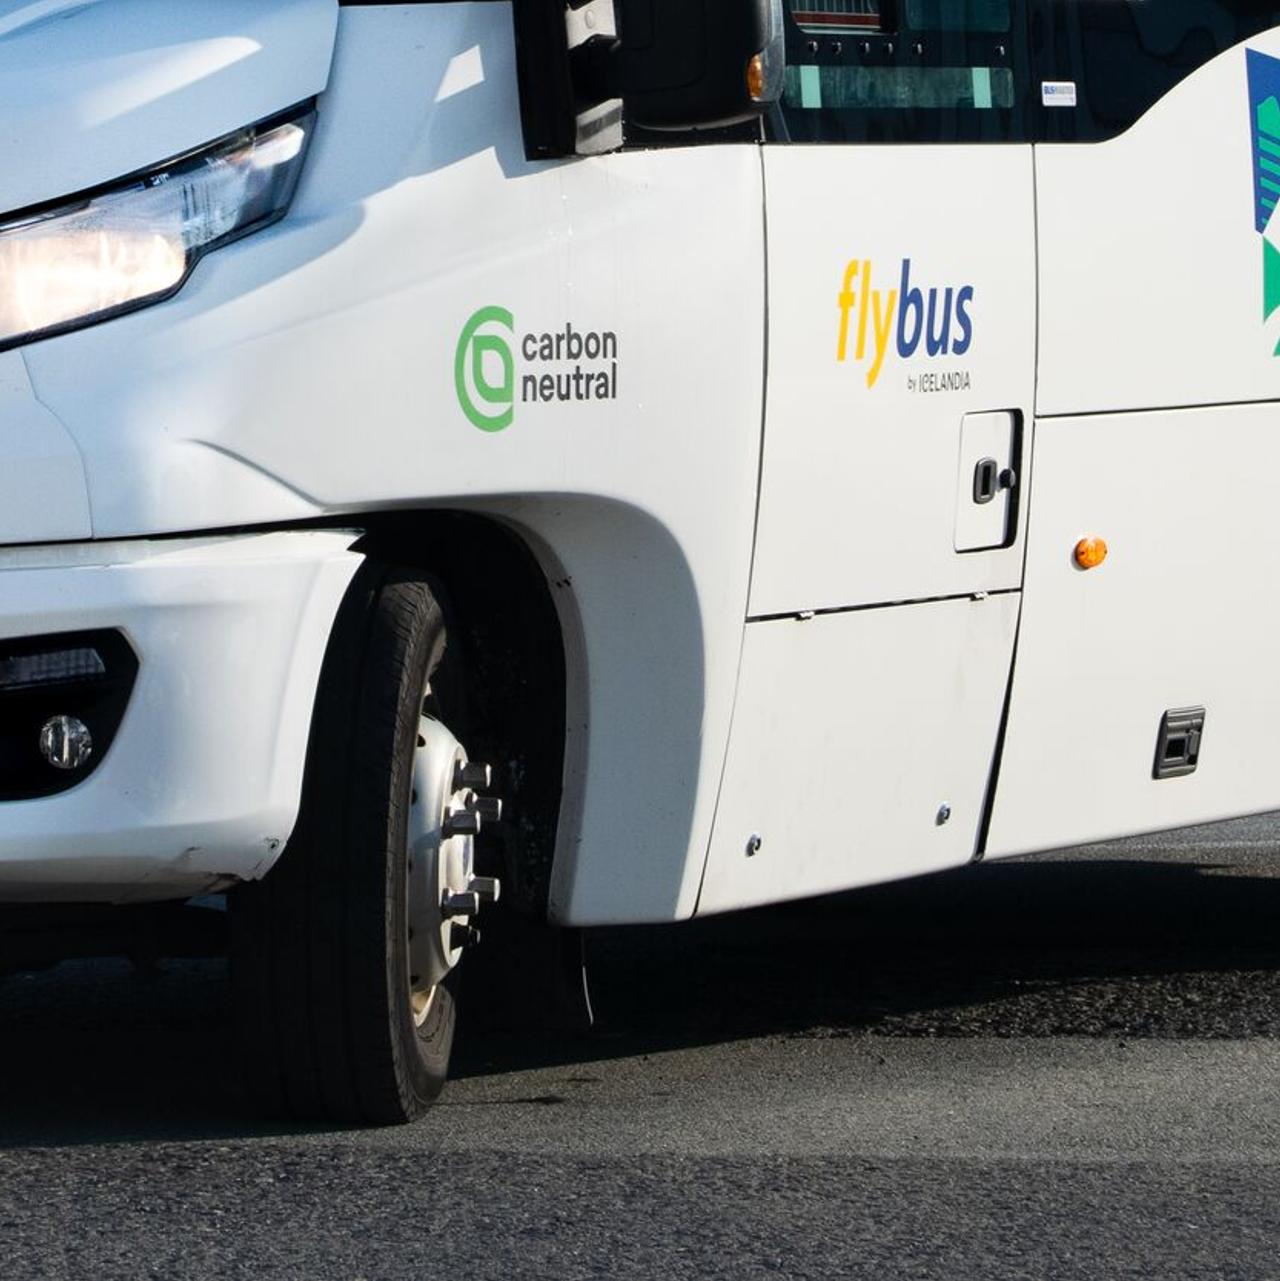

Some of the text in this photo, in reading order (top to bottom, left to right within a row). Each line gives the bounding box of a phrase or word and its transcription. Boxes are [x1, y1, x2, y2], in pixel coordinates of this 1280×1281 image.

[521, 322, 617, 362] carbon
[837, 259, 974, 389] flybus
[521, 362, 617, 403] neutral
[918, 370, 971, 393] ICELANDIA
